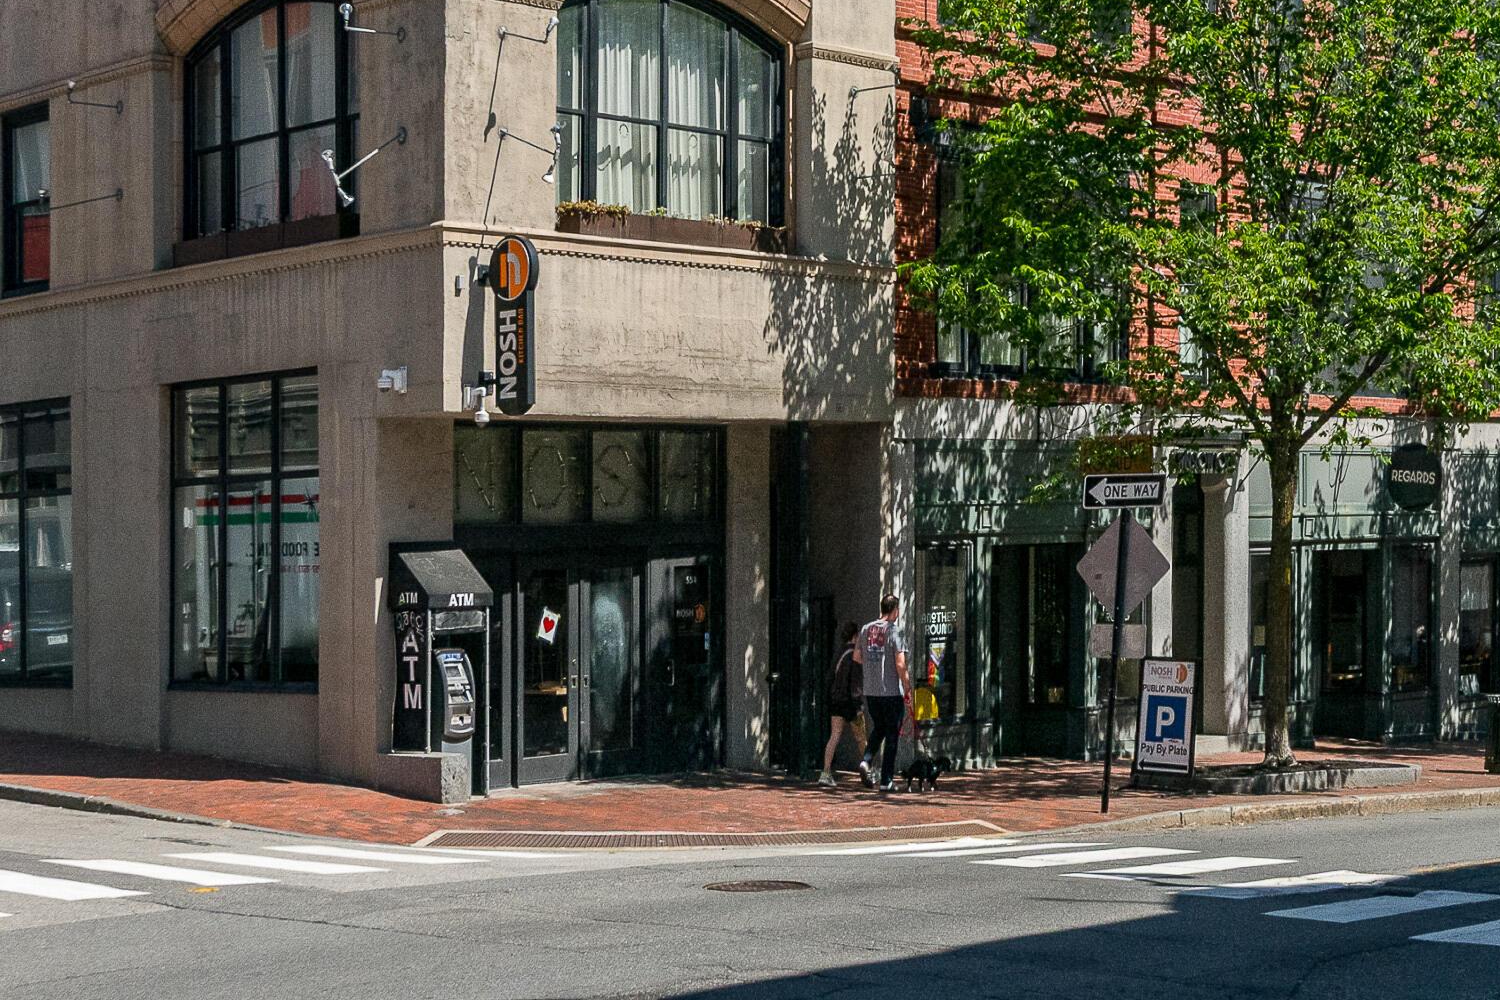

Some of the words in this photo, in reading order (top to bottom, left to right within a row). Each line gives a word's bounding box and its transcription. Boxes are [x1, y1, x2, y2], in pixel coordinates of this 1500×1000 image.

[499, 309, 517, 400] NOSH
[1391, 469, 1436, 485] REGARDS
[1103, 485, 1128, 498] ONE
[1133, 483, 1158, 497] WAY
[399, 592, 418, 604] ATM
[449, 593, 474, 607] ATM
[922, 611, 957, 623] ANOTHER
[925, 623, 953, 635] ROUND
[402, 629, 422, 710] ATM
[1150, 666, 1173, 676] NOSH
[1143, 684, 1166, 693] PUBLIC
[1166, 685, 1195, 694] PARKING
[1155, 705, 1175, 737] P
[1140, 743, 1154, 755] Pay
[1156, 744, 1167, 756] By
[1168, 745, 1188, 756] Plate
